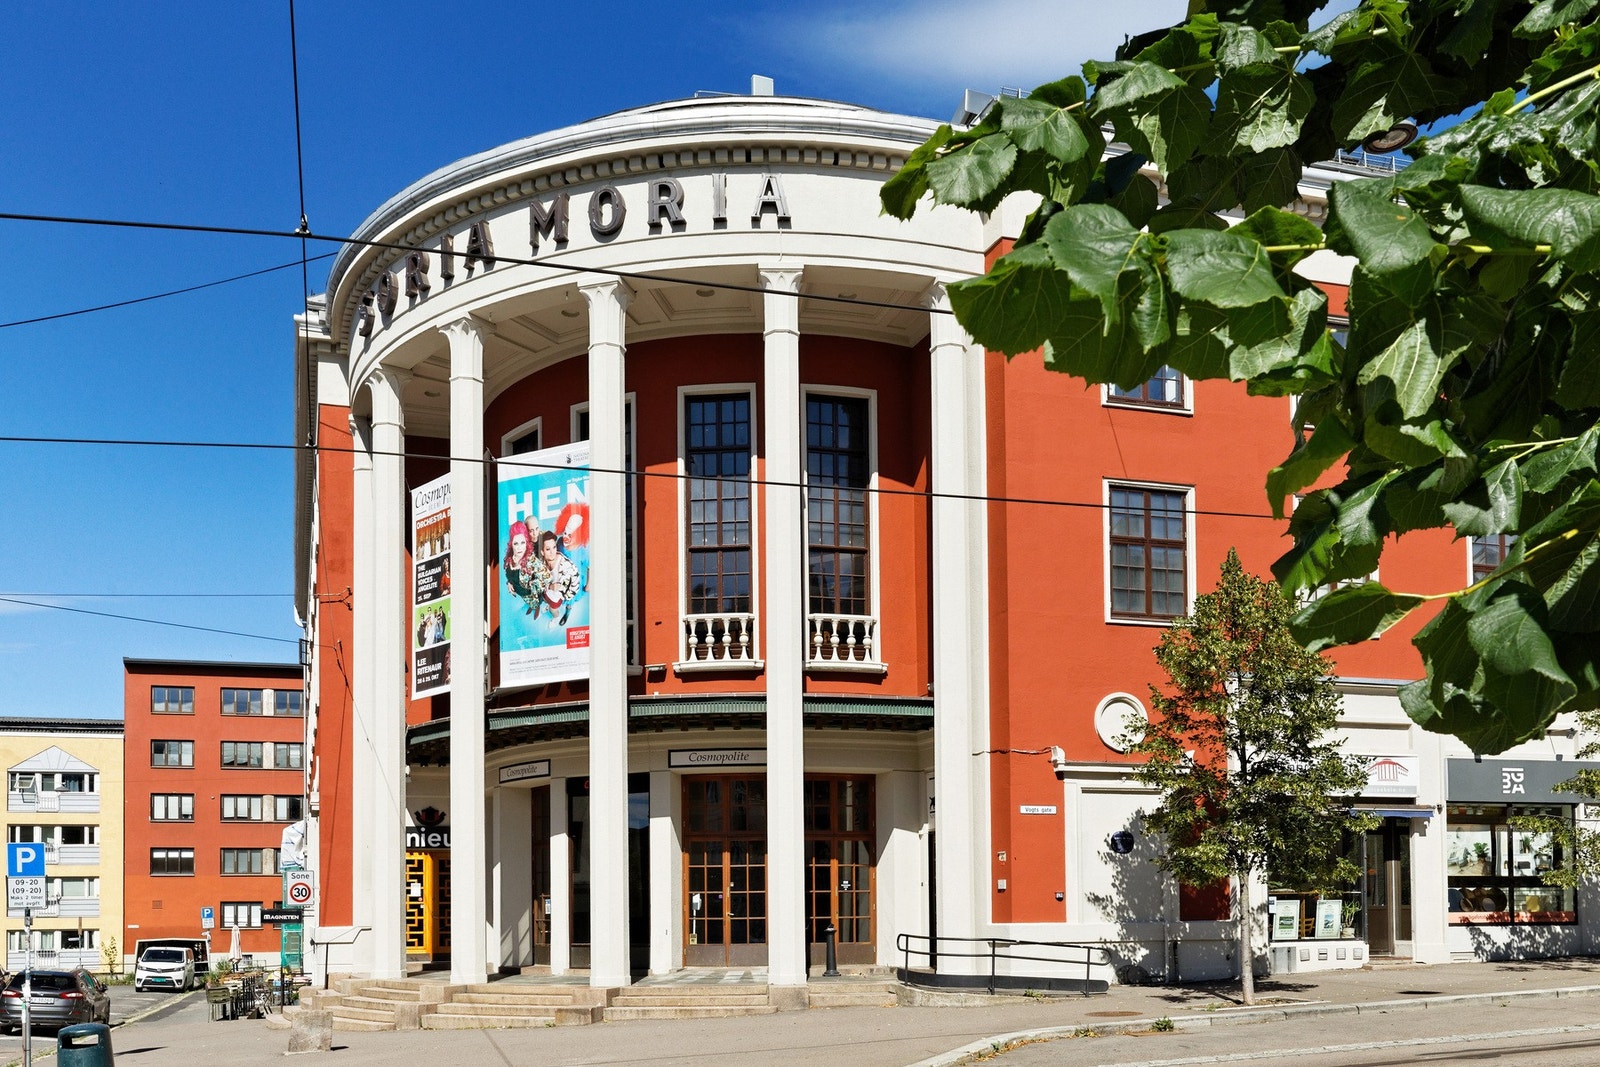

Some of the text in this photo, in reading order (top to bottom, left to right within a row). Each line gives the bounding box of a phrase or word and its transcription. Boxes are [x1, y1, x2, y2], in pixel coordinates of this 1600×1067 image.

[358, 172, 791, 337] SORIA MORIA
[417, 511, 447, 530] ORCHESTRA
[417, 566, 442, 579] BULGARIAN
[417, 658, 427, 667] LEE
[688, 751, 750, 764] Cosmopolite
[506, 764, 538, 777] Cosmopolite
[16, 847, 36, 873] P
[294, 887, 308, 898] 30
[204, 908, 211, 918] P
